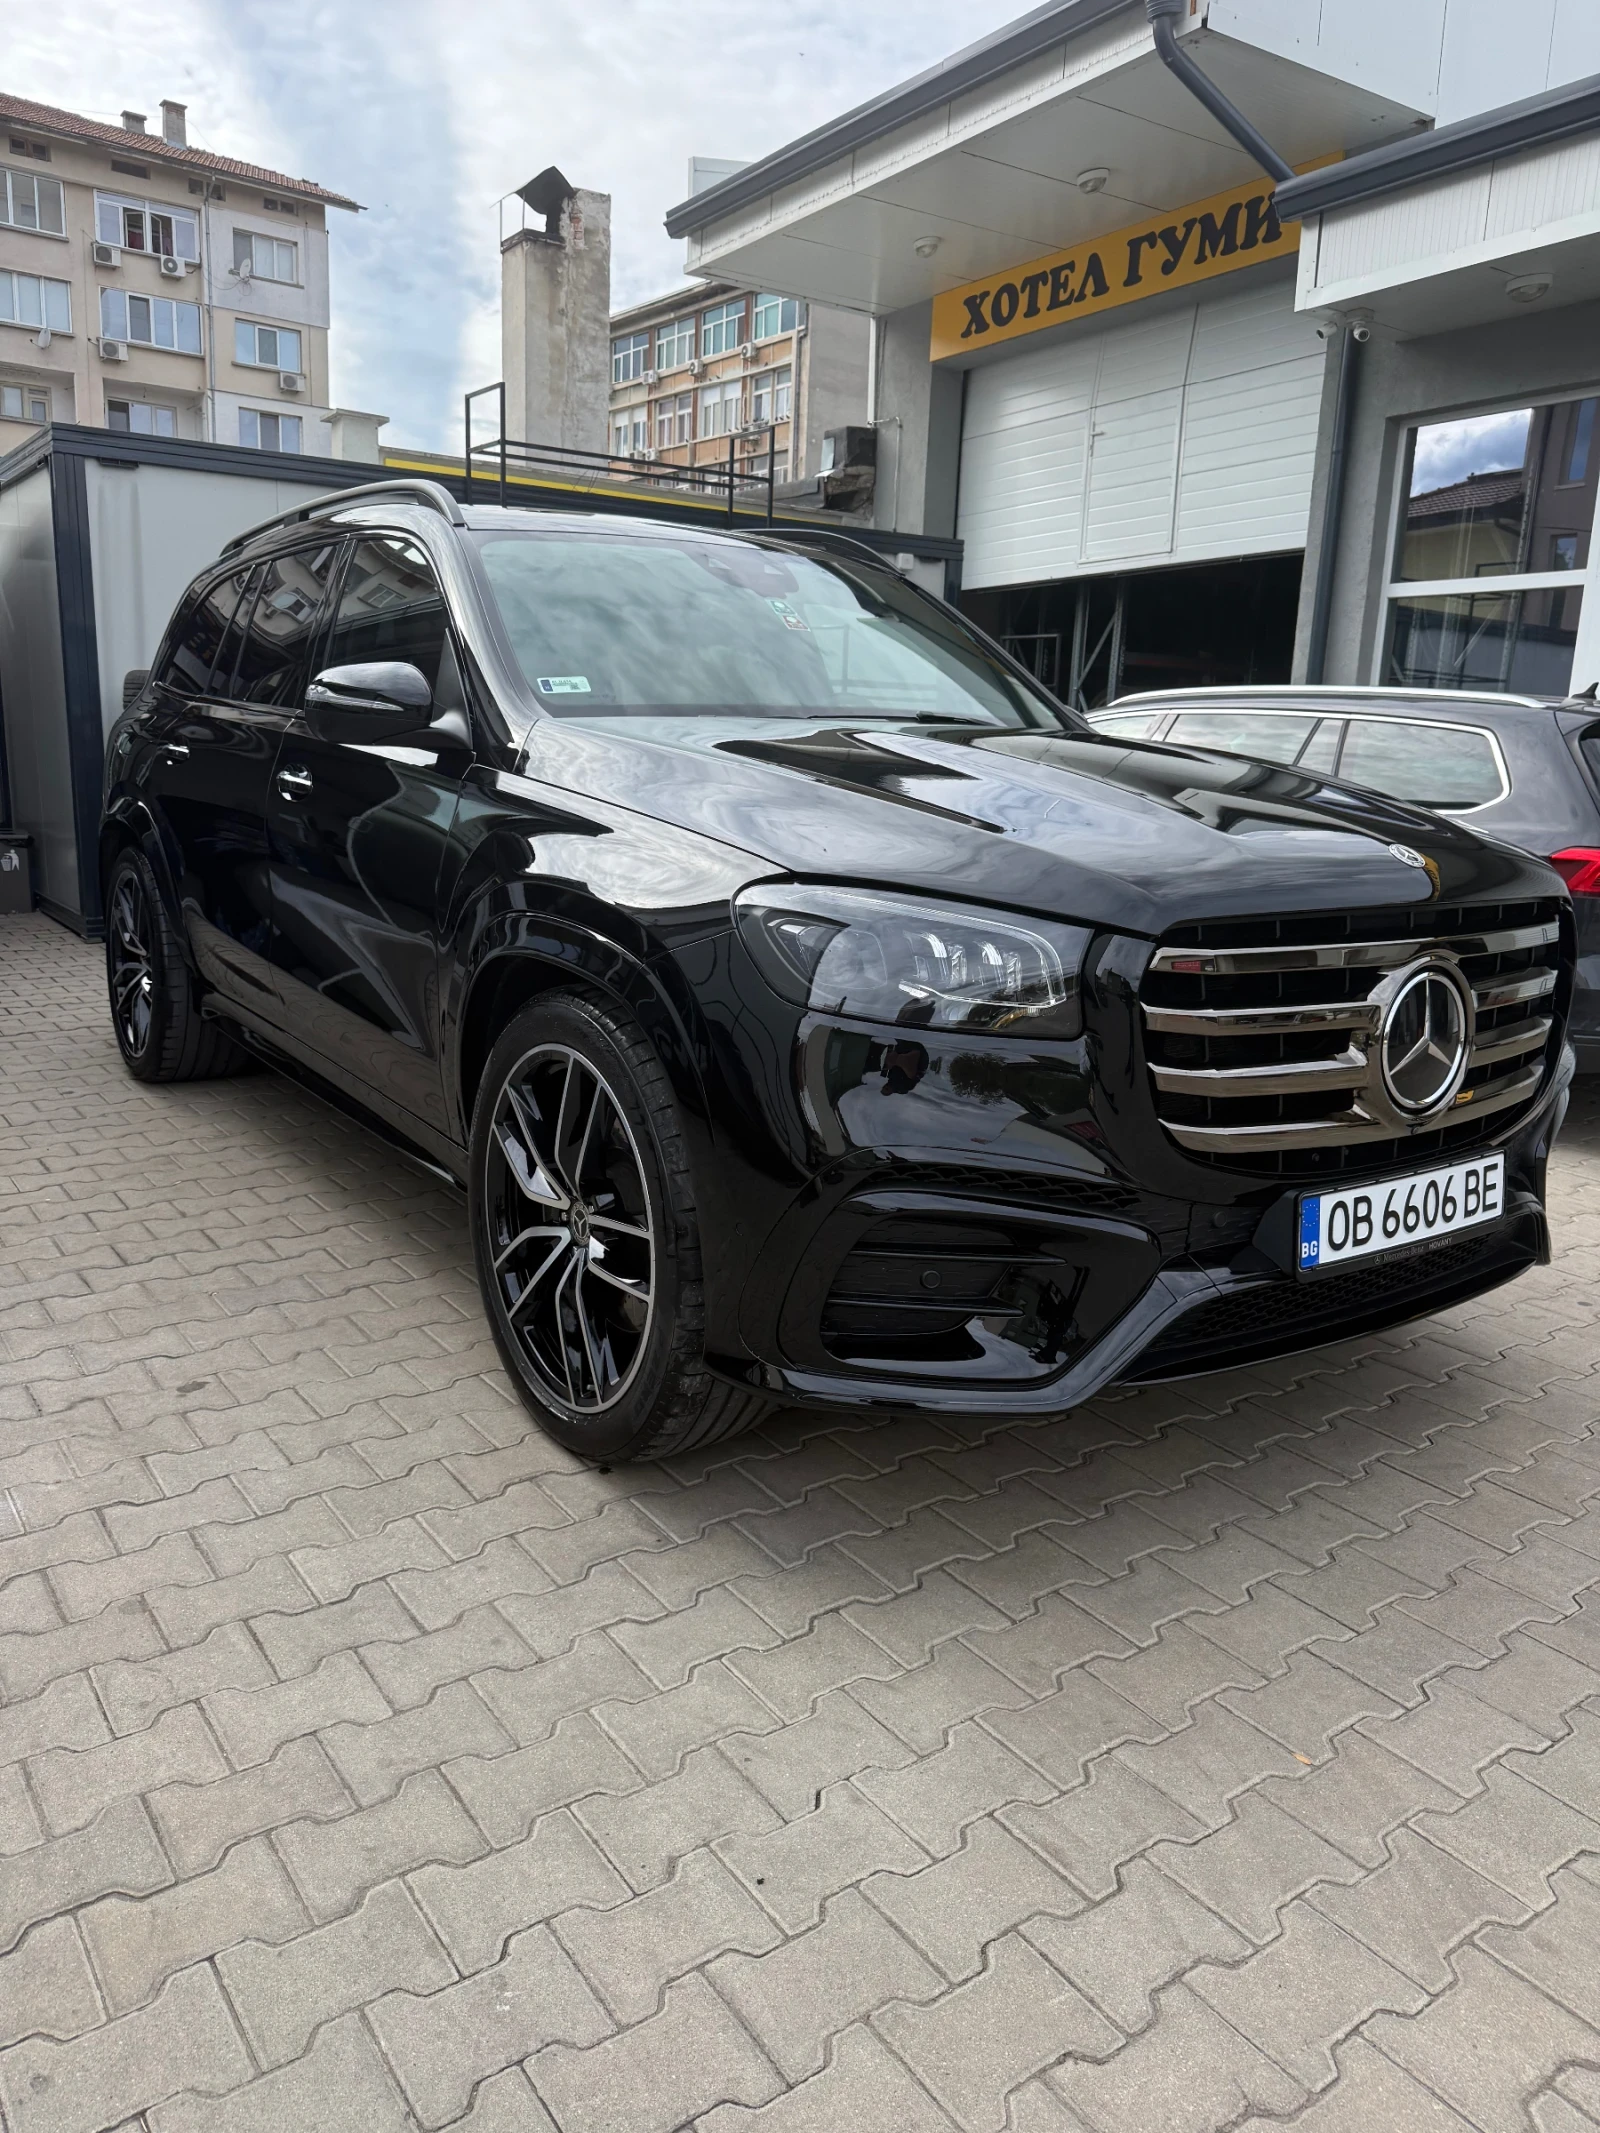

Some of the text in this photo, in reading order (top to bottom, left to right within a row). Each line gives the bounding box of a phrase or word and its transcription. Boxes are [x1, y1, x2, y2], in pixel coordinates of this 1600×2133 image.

[960, 191, 1283, 339] ХОТЕЛ ГУМИ
[1301, 1240, 1319, 1259] BG
[1327, 1162, 1499, 1252] OB 6606 BE
